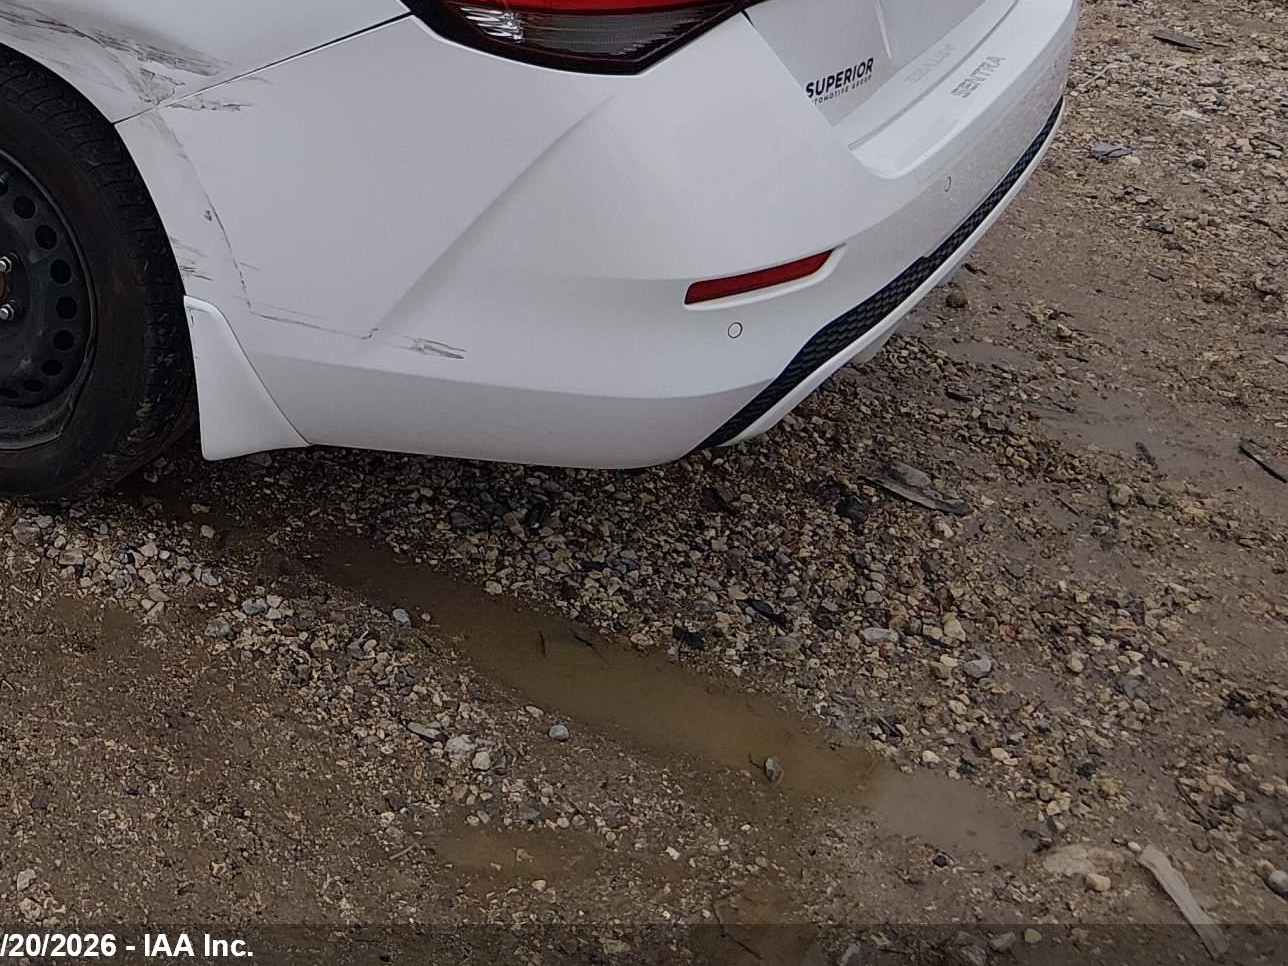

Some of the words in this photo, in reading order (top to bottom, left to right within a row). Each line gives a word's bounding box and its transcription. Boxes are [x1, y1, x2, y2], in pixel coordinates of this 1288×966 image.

[805, 57, 874, 99] SUPERIOR
[813, 86, 850, 106] TOMOTIVE
[950, 56, 1006, 99] SENTRA
